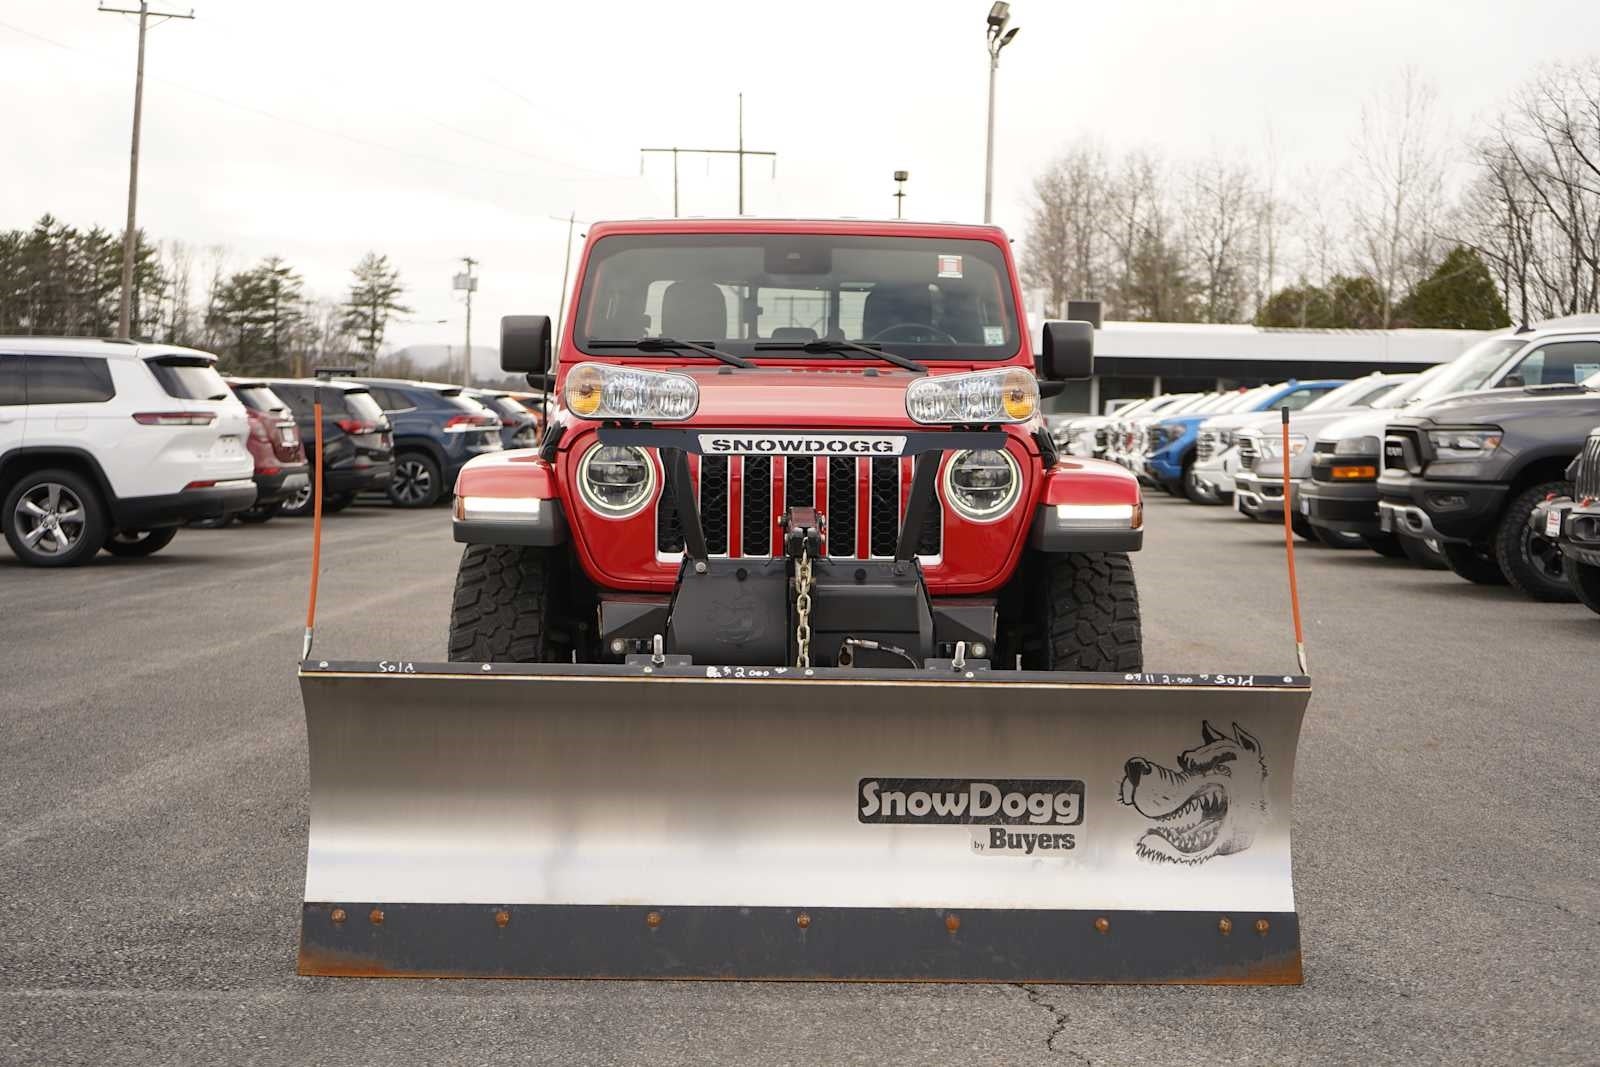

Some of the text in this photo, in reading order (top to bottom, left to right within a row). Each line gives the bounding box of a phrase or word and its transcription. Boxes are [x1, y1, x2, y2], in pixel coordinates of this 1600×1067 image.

[712, 439, 894, 452] SNOWDOGG
[379, 660, 416, 673] Sold
[1214, 674, 1254, 686] Sold
[861, 781, 1080, 824] SnowDogg
[974, 827, 1076, 854] by Buyers
